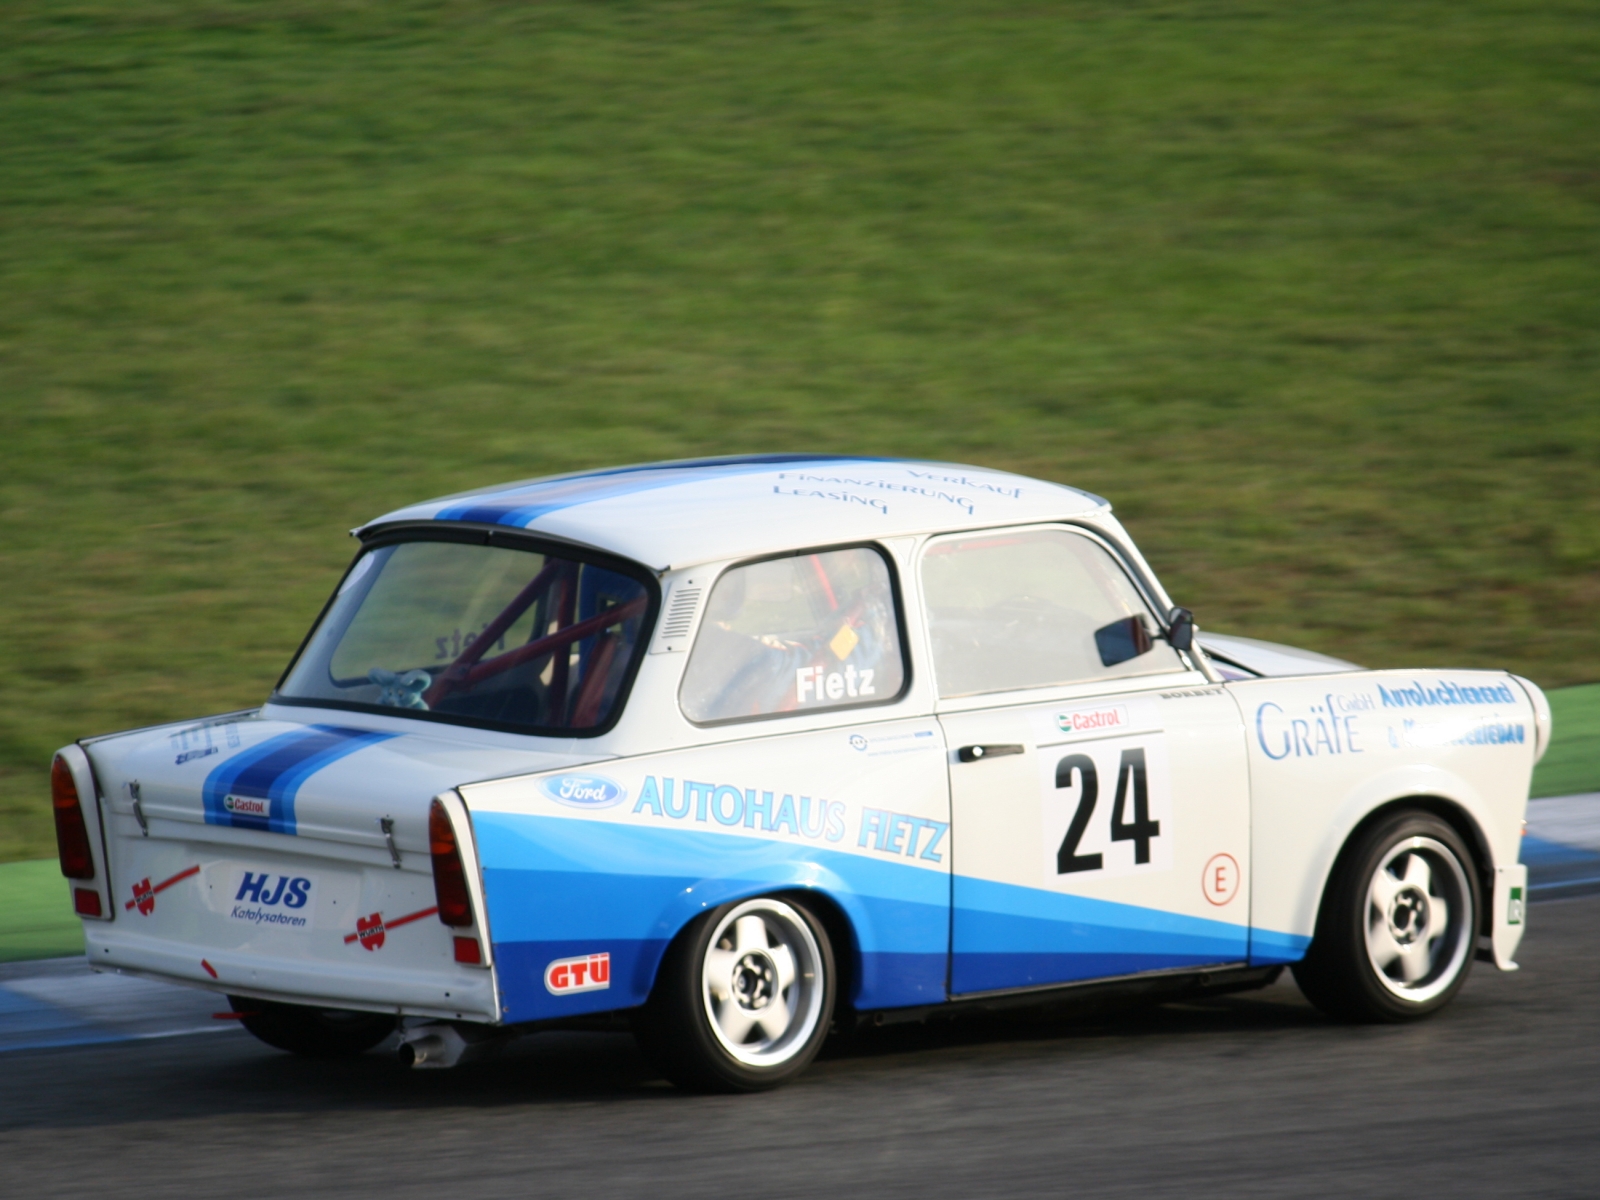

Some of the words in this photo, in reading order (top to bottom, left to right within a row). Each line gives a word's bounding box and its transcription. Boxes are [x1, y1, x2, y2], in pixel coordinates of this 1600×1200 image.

[796, 667, 876, 703] Fietz
[1072, 709, 1122, 731] Castrol
[558, 777, 607, 802] Ford
[234, 798, 264, 814] Castrol
[632, 775, 847, 843] AUTOHAUS
[857, 806, 950, 863] FIETZ
[1055, 747, 1160, 875] 24
[235, 871, 311, 909] HJS
[1215, 866, 1227, 893] E
[230, 904, 307, 927] Katalysatoren
[549, 951, 609, 989] GTÜ
